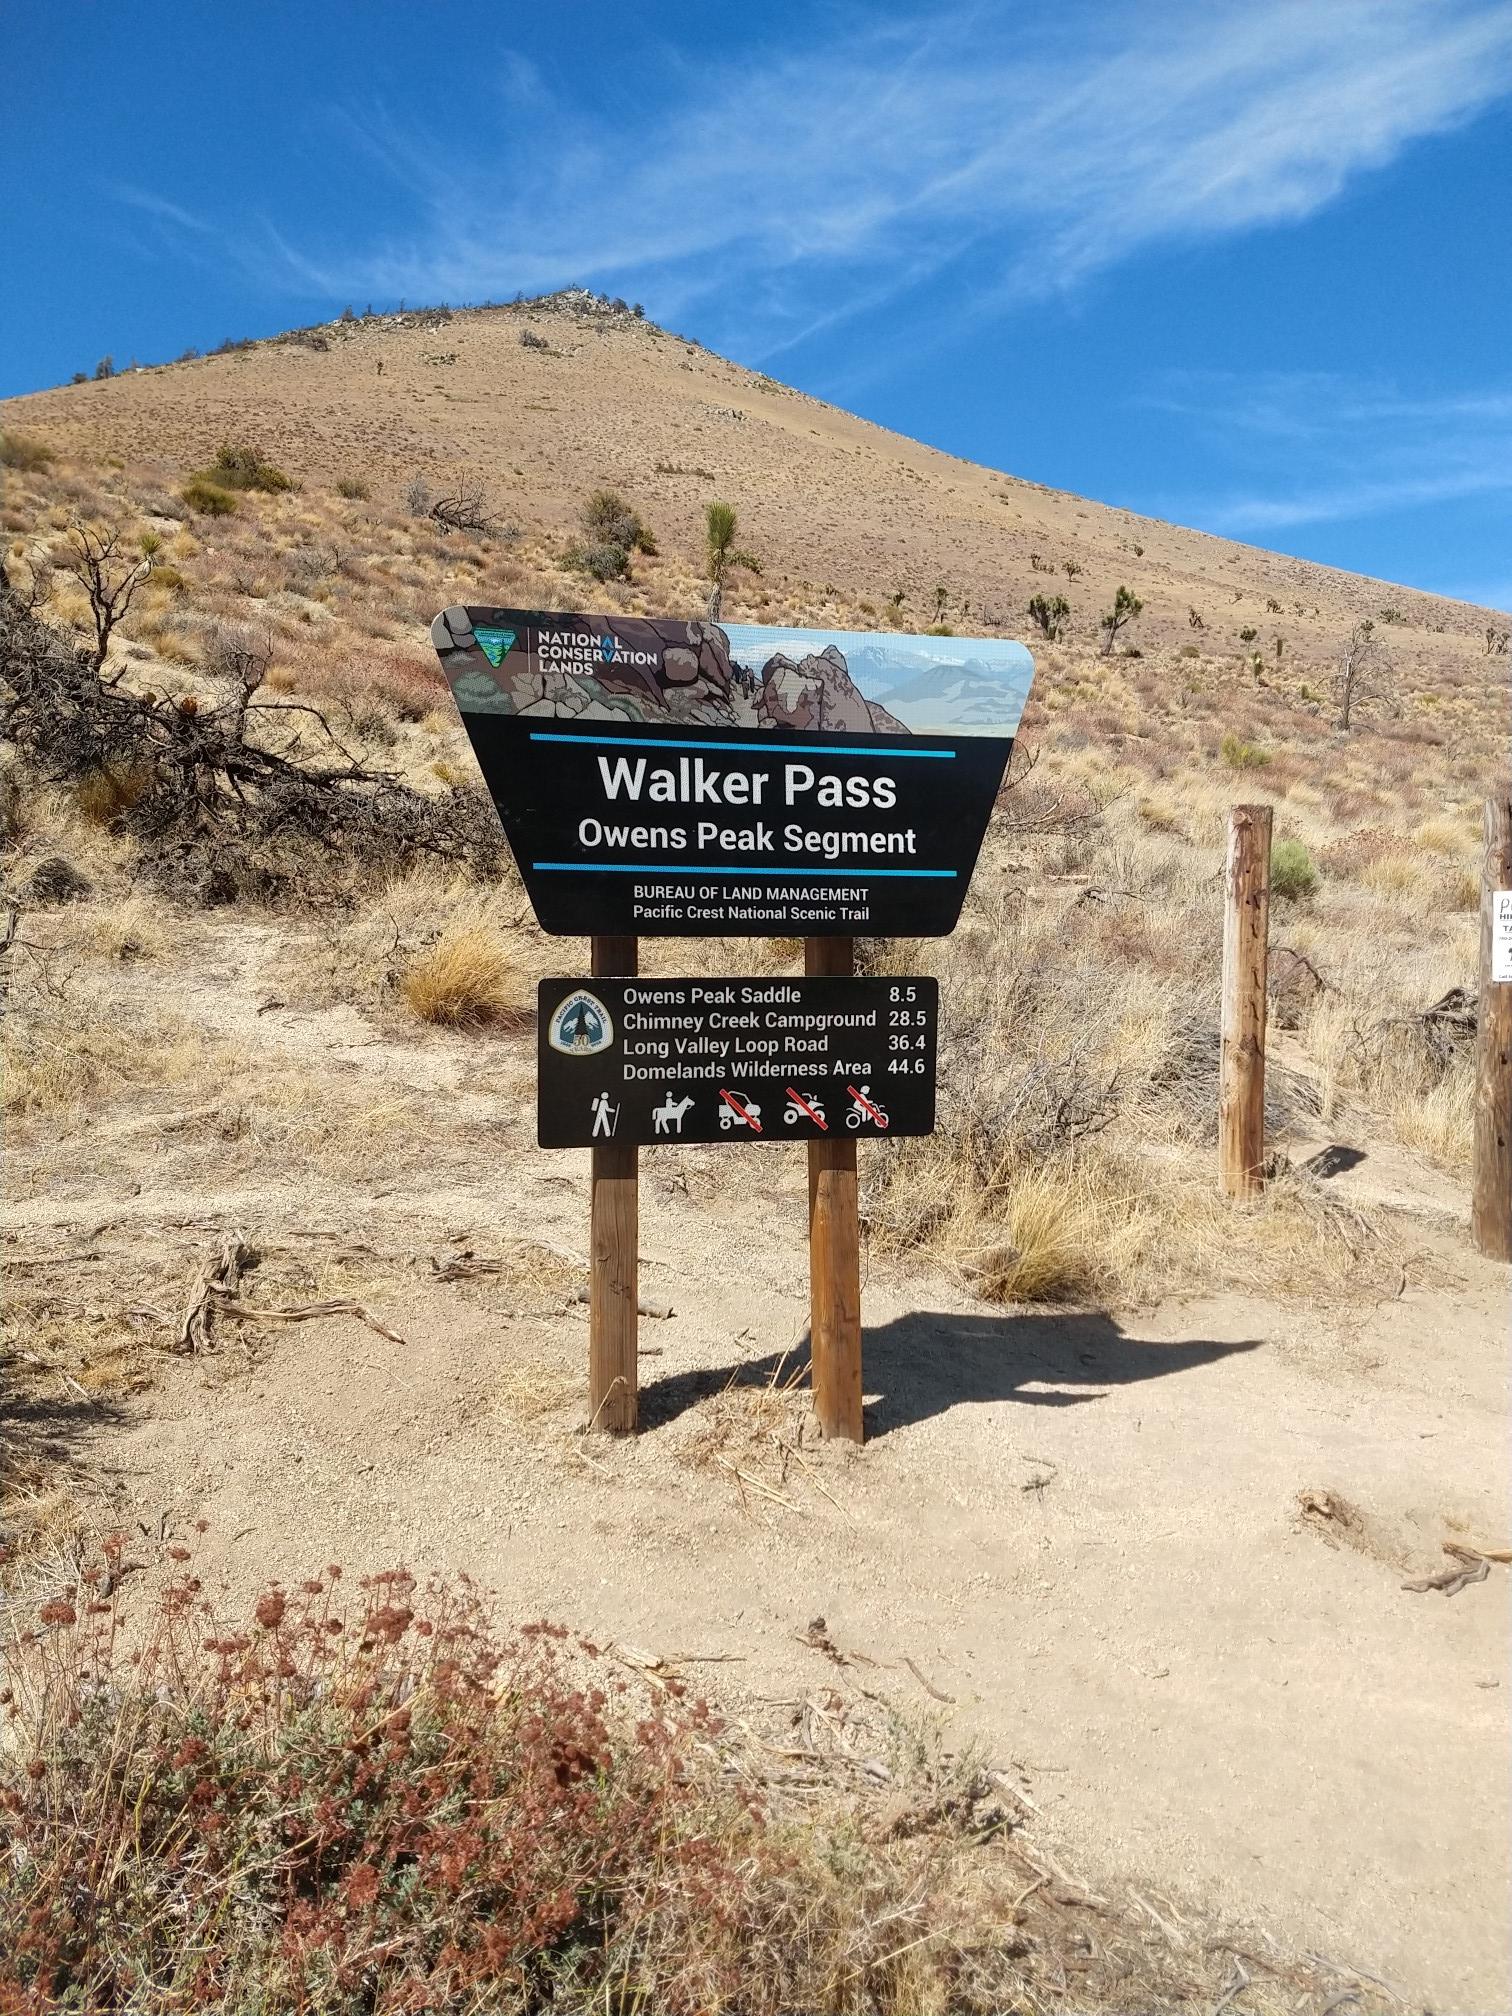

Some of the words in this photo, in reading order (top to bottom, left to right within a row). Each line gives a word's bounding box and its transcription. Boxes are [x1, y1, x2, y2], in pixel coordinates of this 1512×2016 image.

[537, 631, 623, 651] NATIONAL
[537, 644, 658, 666] CONSERVATION
[539, 660, 594, 676] LANDS
[597, 756, 769, 805] Walker
[785, 764, 897, 809] Pass
[578, 818, 687, 849] Owens
[697, 821, 775, 851] Peak
[783, 824, 917, 860] Segment
[633, 885, 695, 899] BUREAU
[699, 886, 719, 900] OF
[722, 886, 762, 900] LAND
[766, 887, 869, 901] MANAGEMENT
[633, 904, 683, 919] Pacific
[687, 905, 725, 919] Crest
[728, 905, 787, 920] National
[790, 906, 836, 920] Scenic
[839, 906, 870, 920] Trail
[623, 988, 686, 1005] Owens
[691, 986, 736, 1004] Peak
[741, 986, 801, 1004] Saddle
[889, 986, 916, 1002] 8.5
[623, 1012, 704, 1033] Chimney
[709, 1011, 760, 1029] Creek
[765, 1009, 877, 1032] Campground
[889, 1010, 927, 1026] 28.5
[623, 1039, 669, 1059] Long
[674, 1036, 730, 1058] Valley
[735, 1037, 779, 1057] Loop
[784, 1034, 828, 1052] Road
[888, 1034, 926, 1051] 36.4
[623, 1061, 726, 1080] Domelands
[730, 1060, 828, 1078] Wilderness
[832, 1059, 872, 1076] Area
[887, 1058, 925, 1075] 44.6
